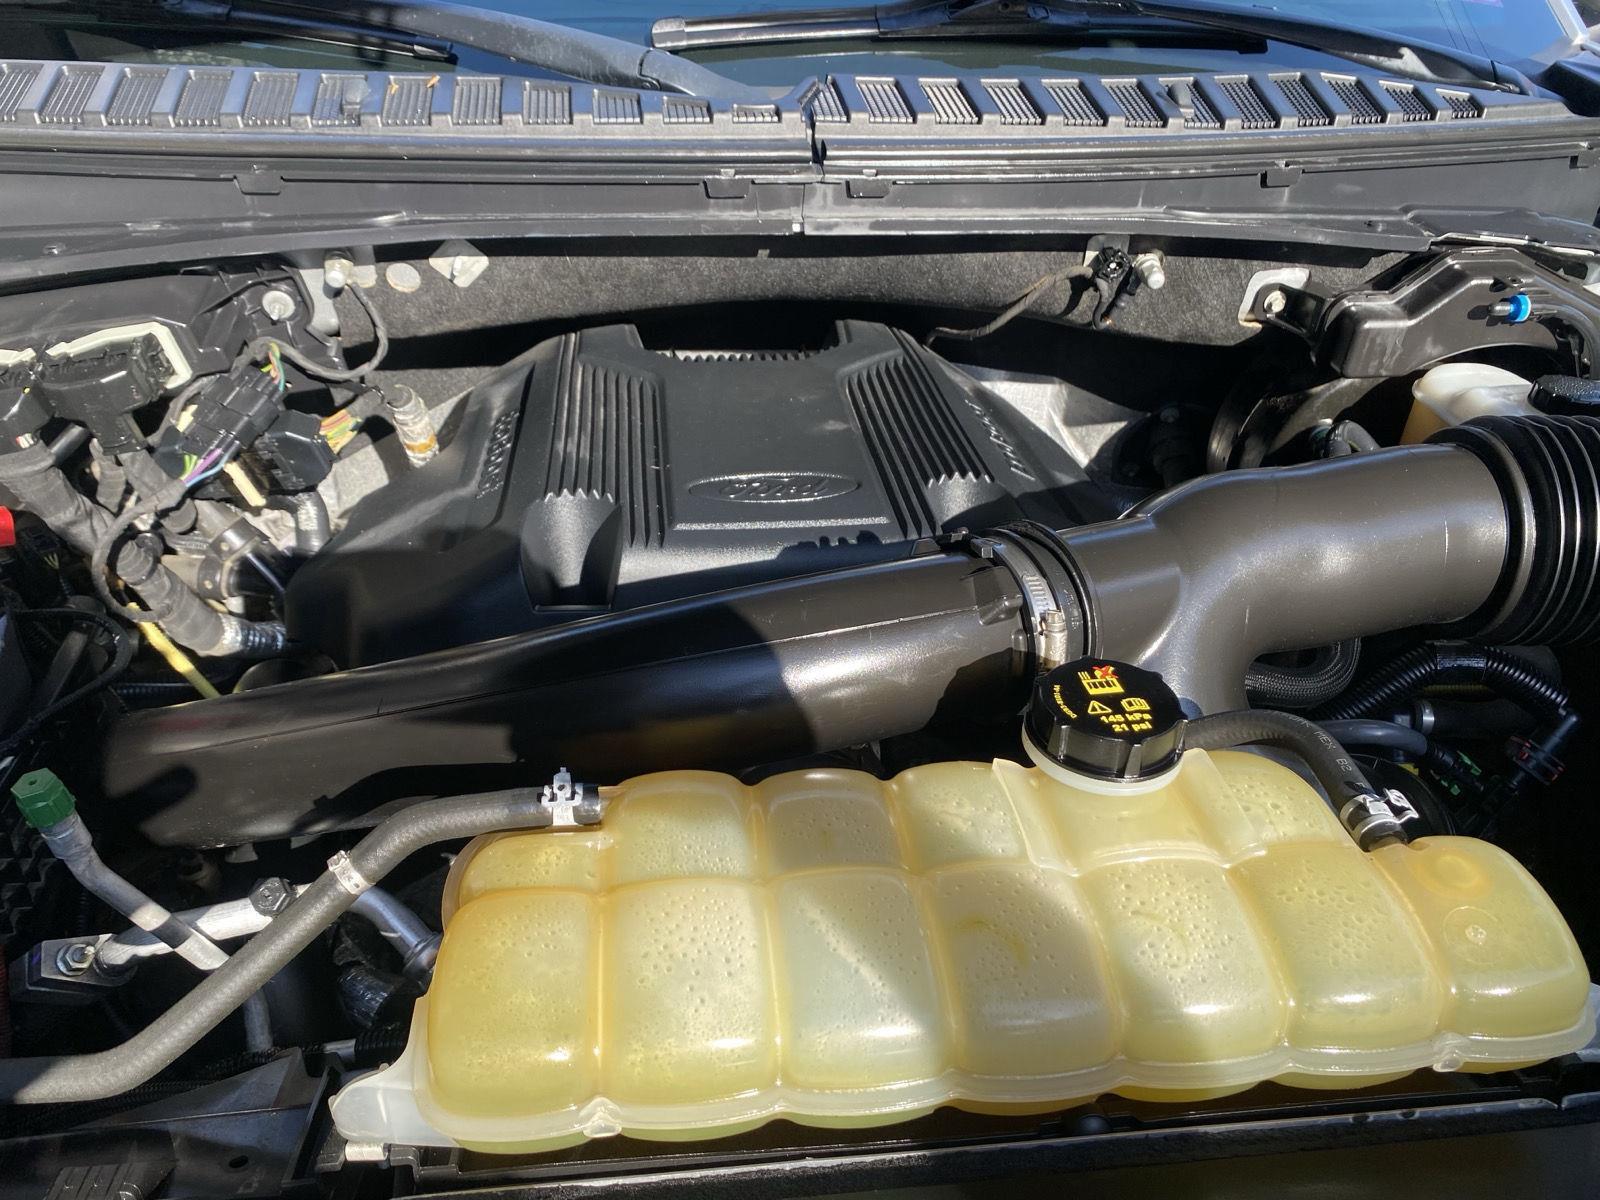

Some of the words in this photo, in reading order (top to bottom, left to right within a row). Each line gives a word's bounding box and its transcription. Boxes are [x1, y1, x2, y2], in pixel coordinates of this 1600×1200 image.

[718, 477, 829, 499] Ford
[1099, 714, 1125, 724] 145
[1125, 712, 1153, 722] kPa
[1112, 722, 1129, 732] 21
[1131, 720, 1153, 732] psi
